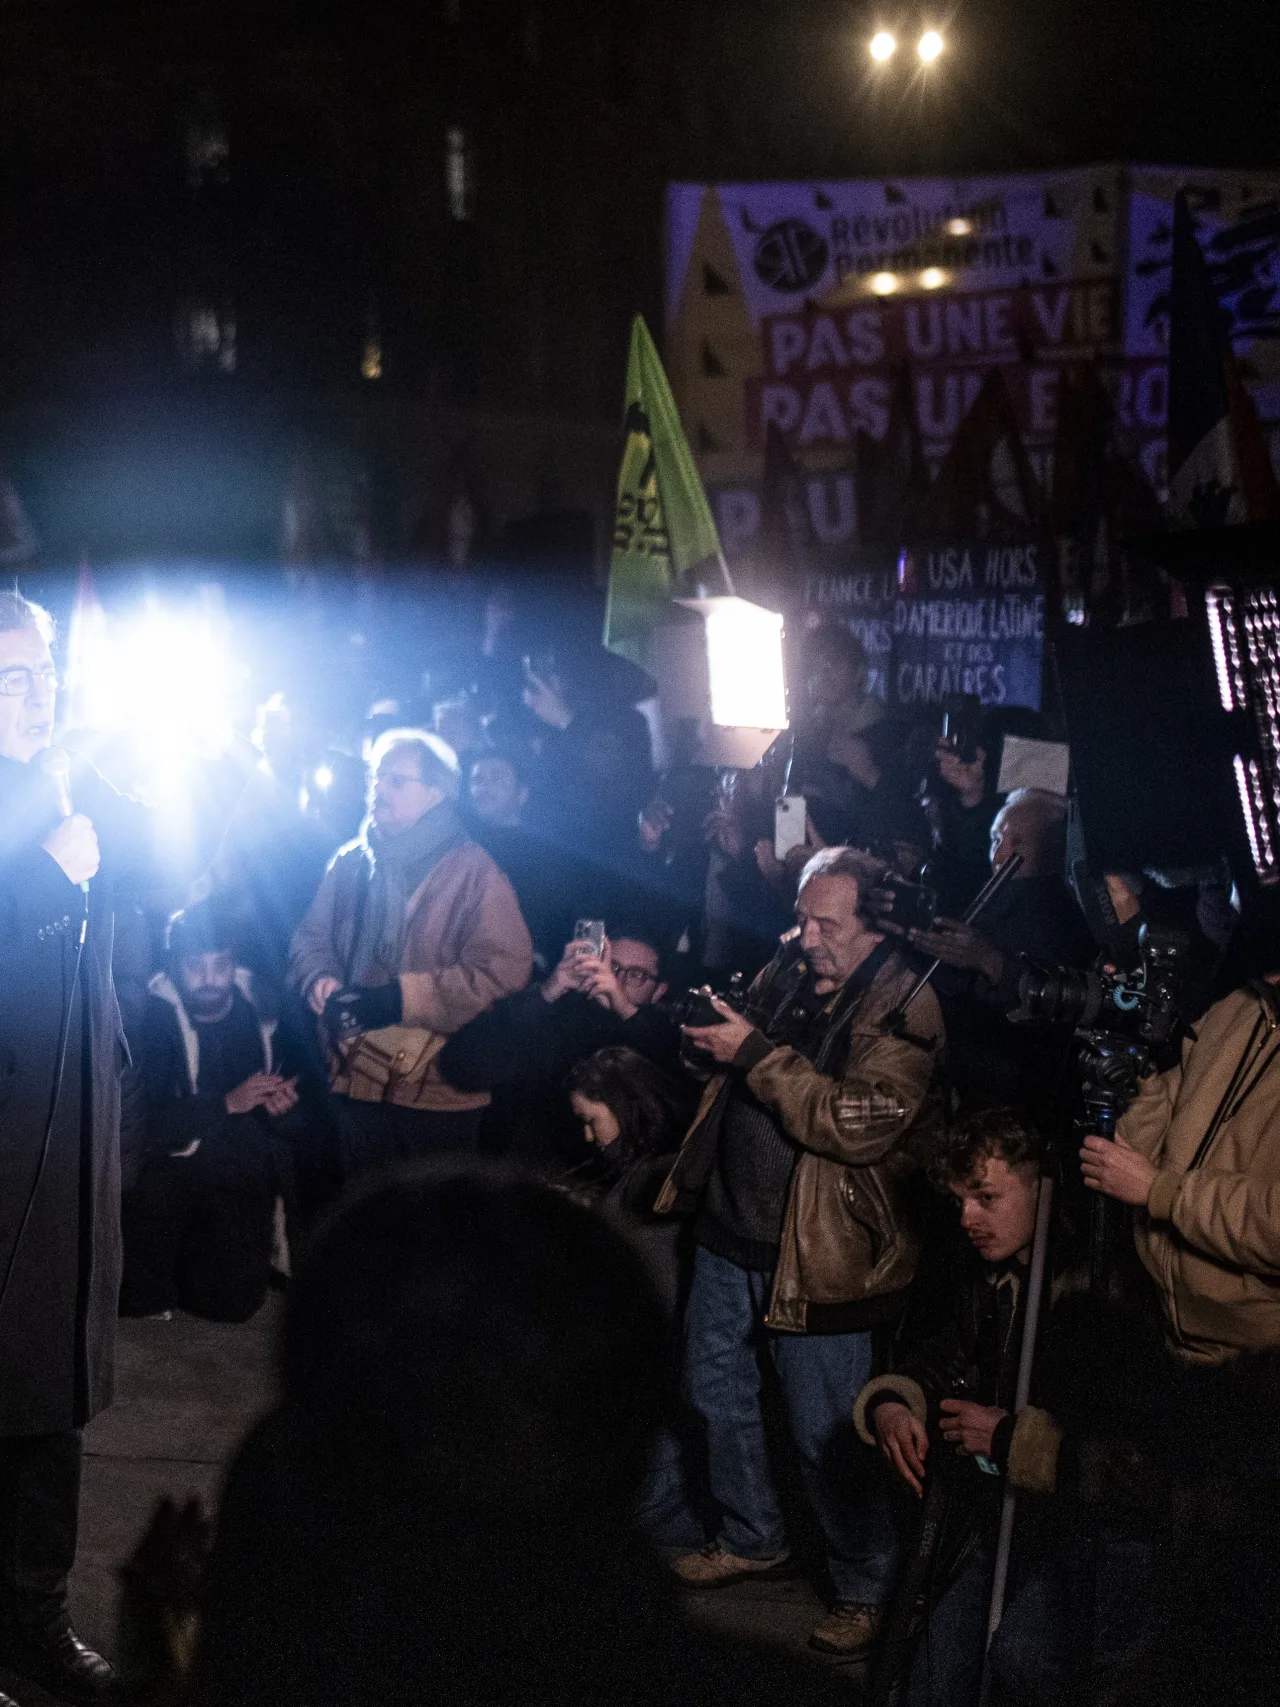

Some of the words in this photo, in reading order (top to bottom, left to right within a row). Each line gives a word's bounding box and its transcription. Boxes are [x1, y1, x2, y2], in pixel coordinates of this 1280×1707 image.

[771, 311, 884, 374] PAS
[904, 295, 1018, 358] UNE
[1031, 287, 1112, 343] VIE
[760, 377, 891, 445] PAS
[927, 548, 973, 590] USA
[985, 544, 1038, 589] HORS
